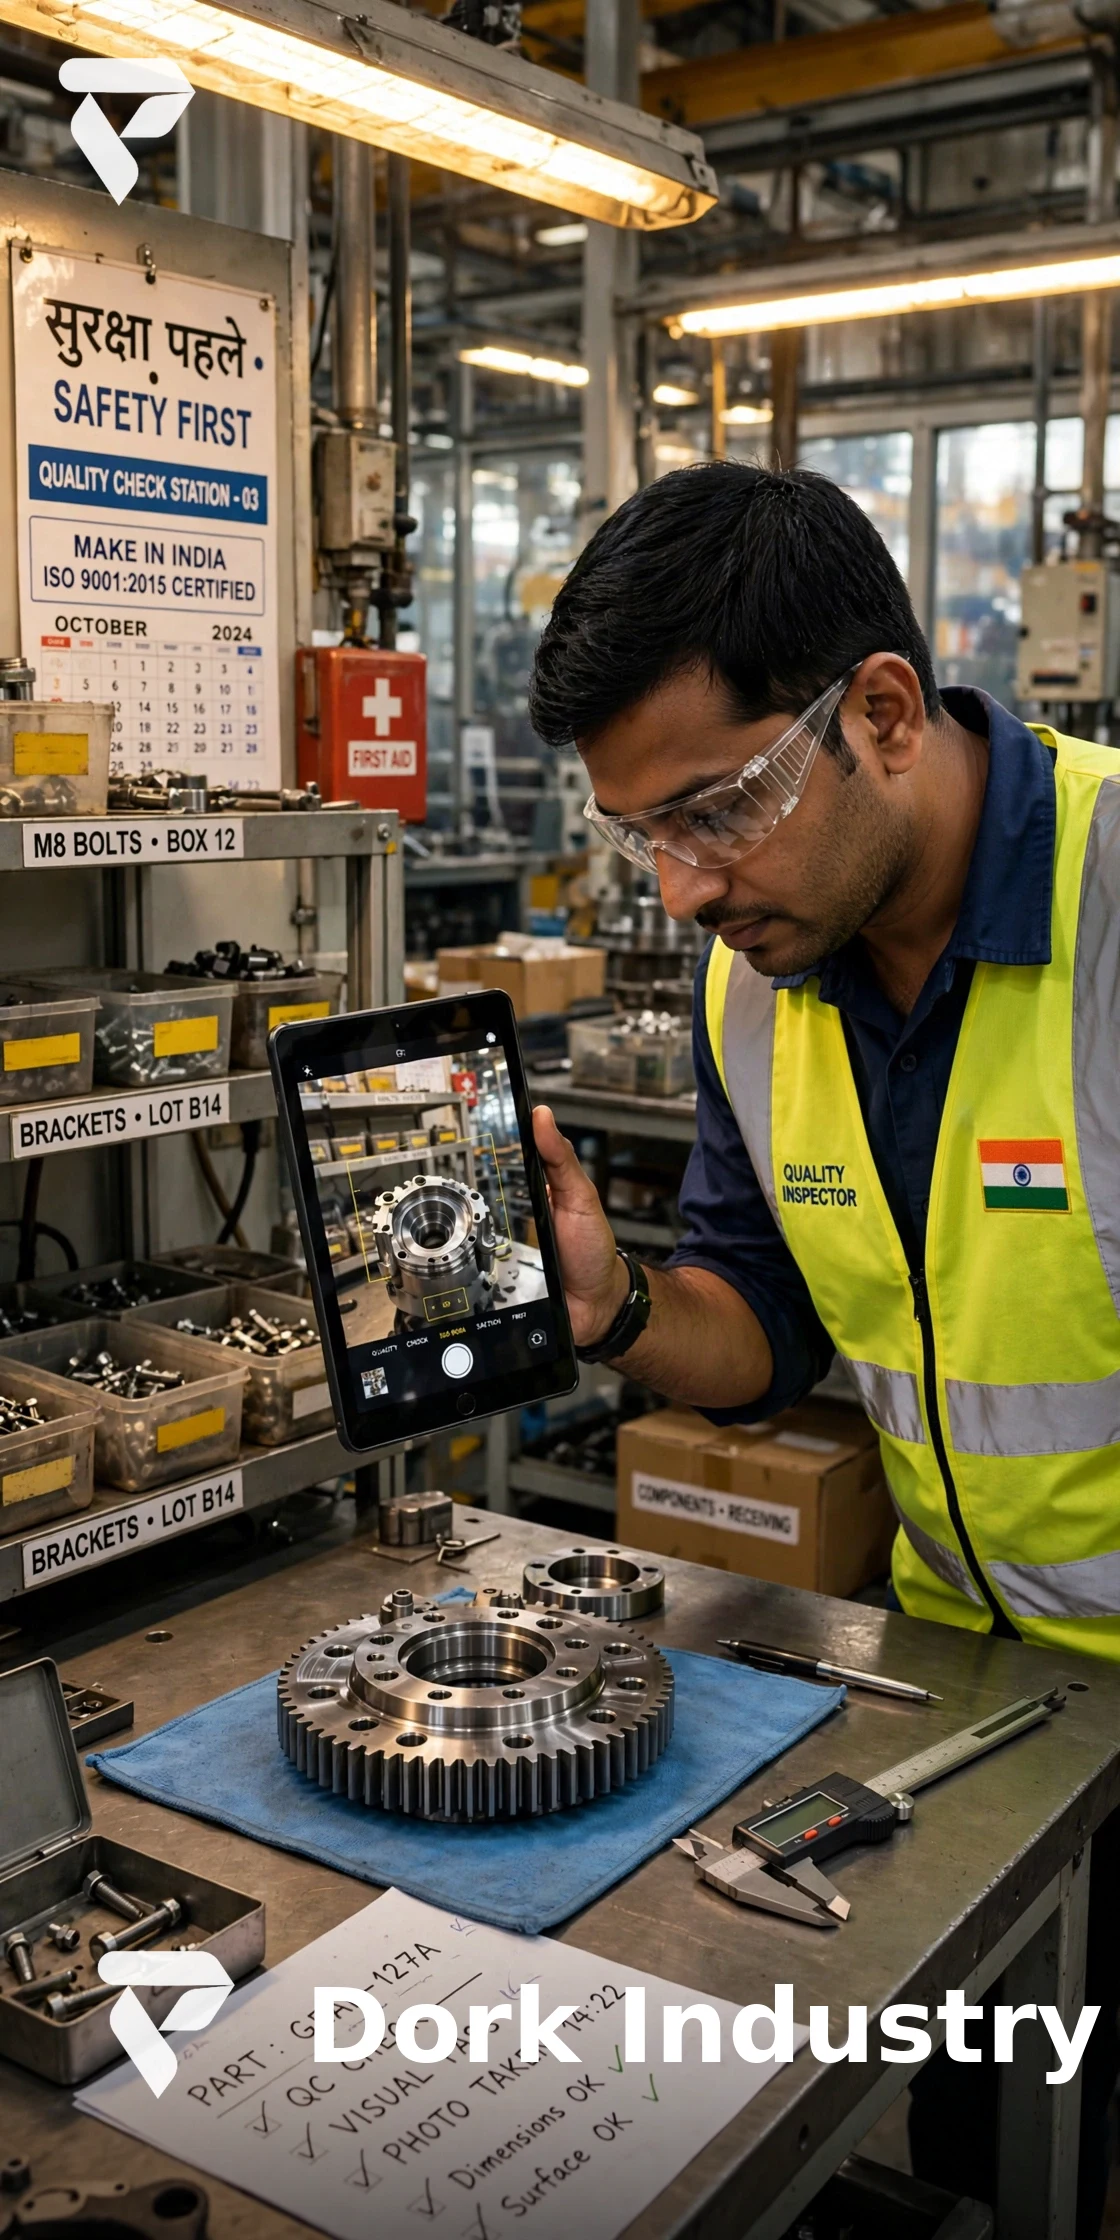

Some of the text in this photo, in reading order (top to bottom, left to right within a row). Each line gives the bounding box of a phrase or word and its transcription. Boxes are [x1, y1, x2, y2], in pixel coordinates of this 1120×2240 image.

[43, 297, 247, 380] सुरक्षा पहले
[54, 379, 252, 449] SAFETY FIRST
[39, 461, 109, 492] QUALITY
[113, 470, 167, 500] CHECK
[170, 477, 230, 507] STATION
[242, 487, 259, 511] 03
[74, 534, 227, 570] MAKE IN INDIA
[44, 566, 255, 601] ISO 9001:2015 CERTIFIED
[55, 615, 252, 641] OCTOBER 2024
[167, 660, 175, 673] 2
[82, 678, 90, 690] 5
[111, 680, 119, 691] 6
[141, 681, 148, 692] 7
[168, 682, 175, 694] 8
[195, 683, 202, 694] 9
[219, 684, 231, 695] 10
[139, 701, 151, 713] 14
[167, 702, 178, 714] 15
[194, 703, 206, 715] 16
[220, 704, 231, 716] 17
[167, 722, 180, 734] 22
[353, 749, 412, 768] FIRST AID
[34, 828, 235, 858] M8 BOLTS BOX 12
[20, 1093, 222, 1148] BRACKETS LOT B14
[783, 1163, 845, 1184] QUALITY
[782, 1185, 857, 1207] INSPECTOR
[638, 1483, 792, 1535] COMPONENTS RECEIVING
[32, 1480, 235, 1576] BRACKETS LOT B14
[187, 2050, 267, 2107] PART
[286, 2075, 336, 2107] QC
[328, 2070, 434, 2134] VISUAL
[382, 2100, 470, 2165] PHOTO
[448, 2074, 606, 2190] Dimensions OK
[501, 2112, 634, 2217] Surface OK
